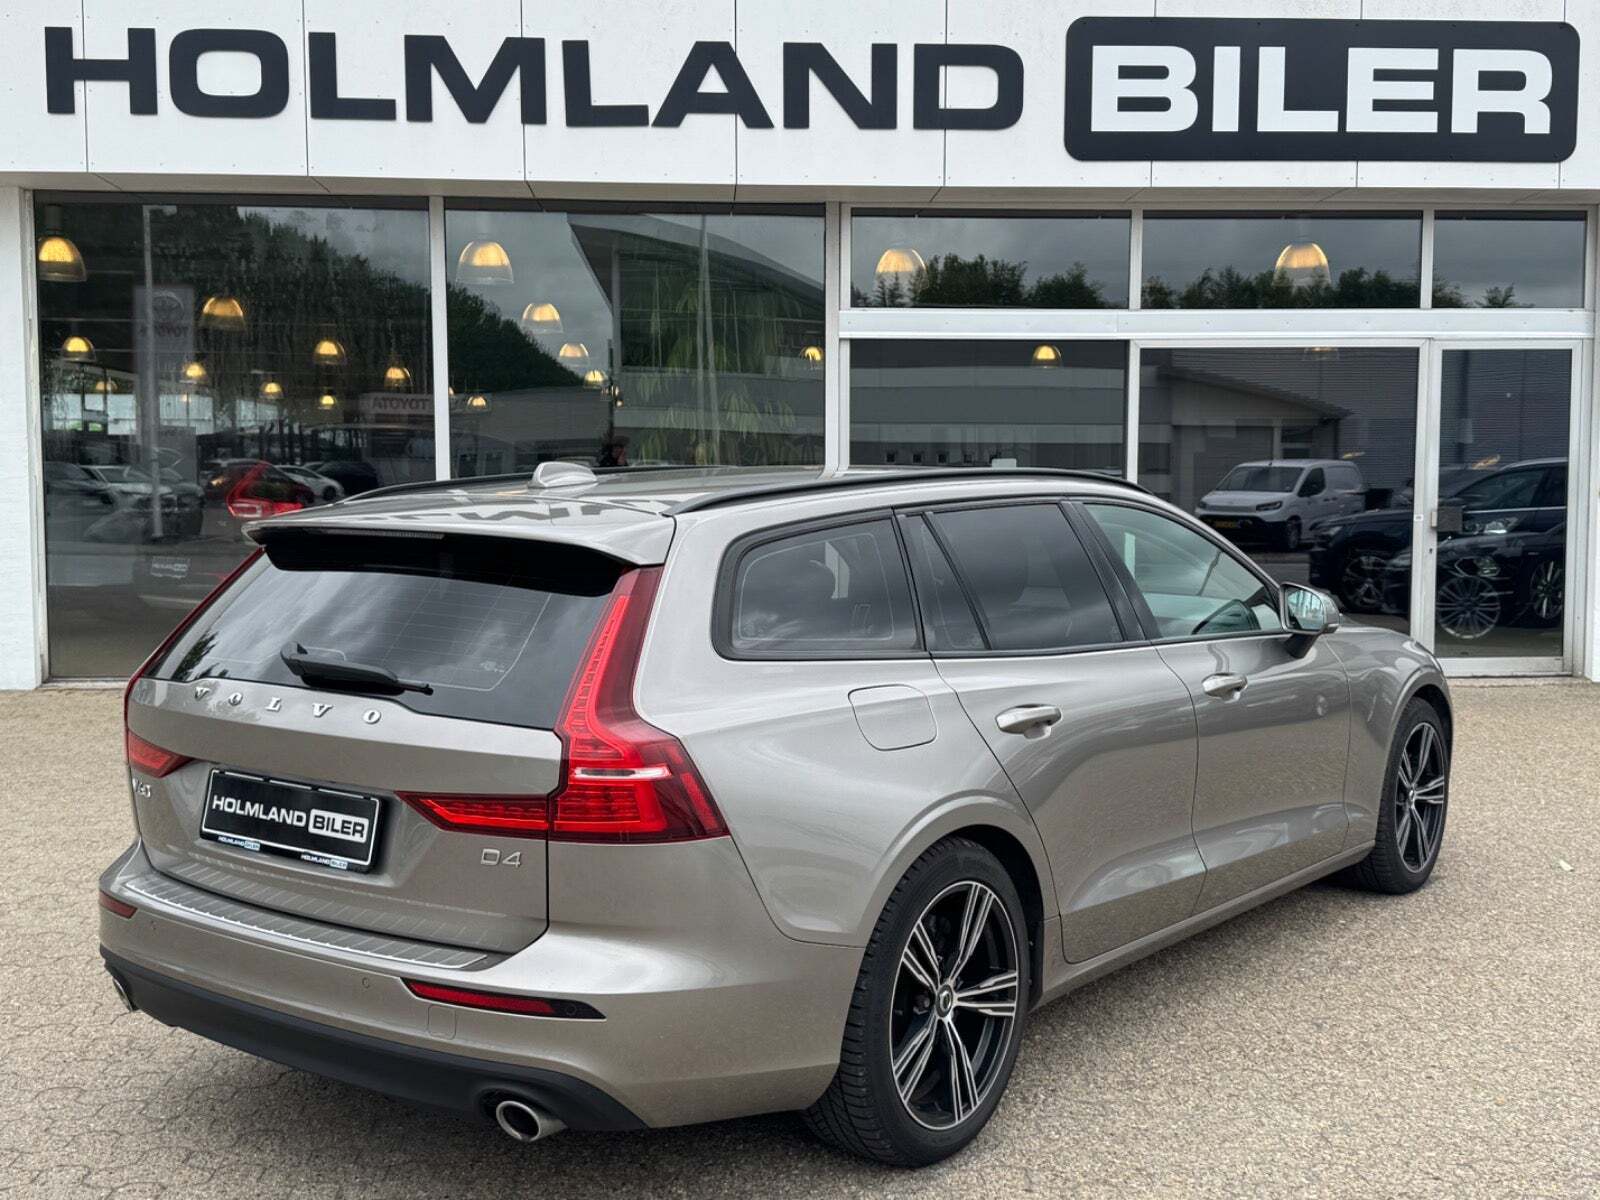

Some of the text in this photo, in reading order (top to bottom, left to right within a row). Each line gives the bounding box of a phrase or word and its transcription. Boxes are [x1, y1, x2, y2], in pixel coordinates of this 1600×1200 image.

[45, 27, 1552, 134] HOLMLAND BILER
[194, 686, 382, 724] VOLVO
[212, 795, 365, 838] HOLMLAND BILER
[480, 848, 521, 868] D4
